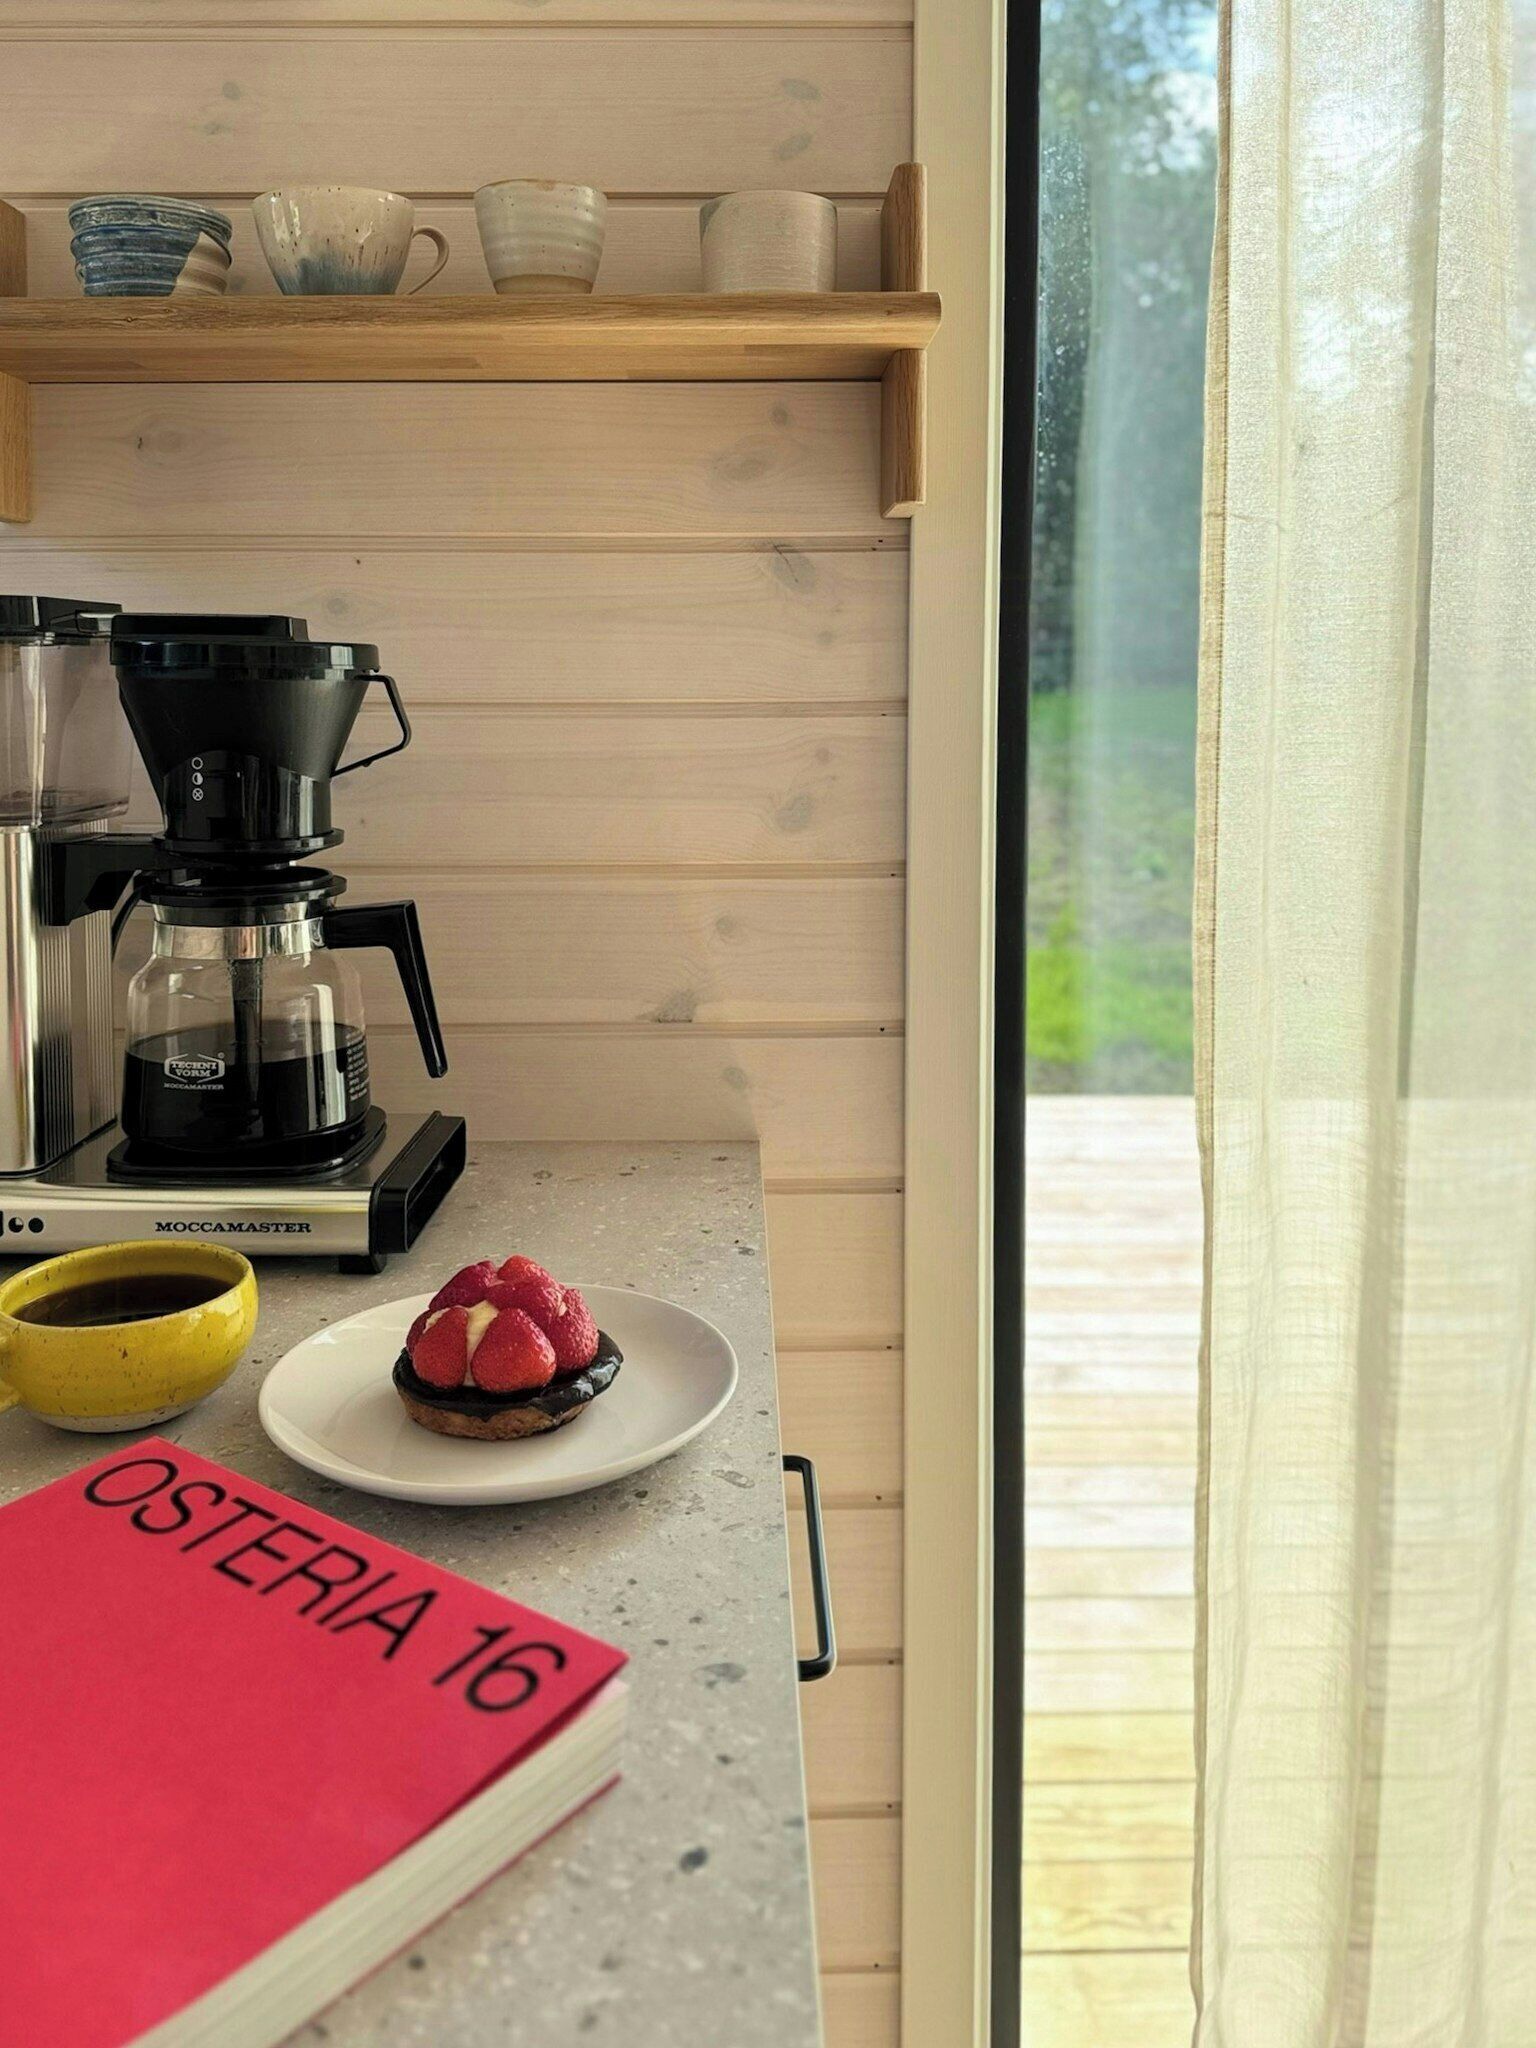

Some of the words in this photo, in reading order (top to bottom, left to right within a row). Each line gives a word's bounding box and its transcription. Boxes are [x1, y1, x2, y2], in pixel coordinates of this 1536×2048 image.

[170, 1061, 217, 1070] TECHNI
[175, 1069, 211, 1077] VORM
[163, 1082, 225, 1090] MOCCAMASTER
[155, 1222, 312, 1233] MOCCAMASTER
[83, 1457, 439, 1661] OSTERIA
[432, 1624, 568, 1714] 16
